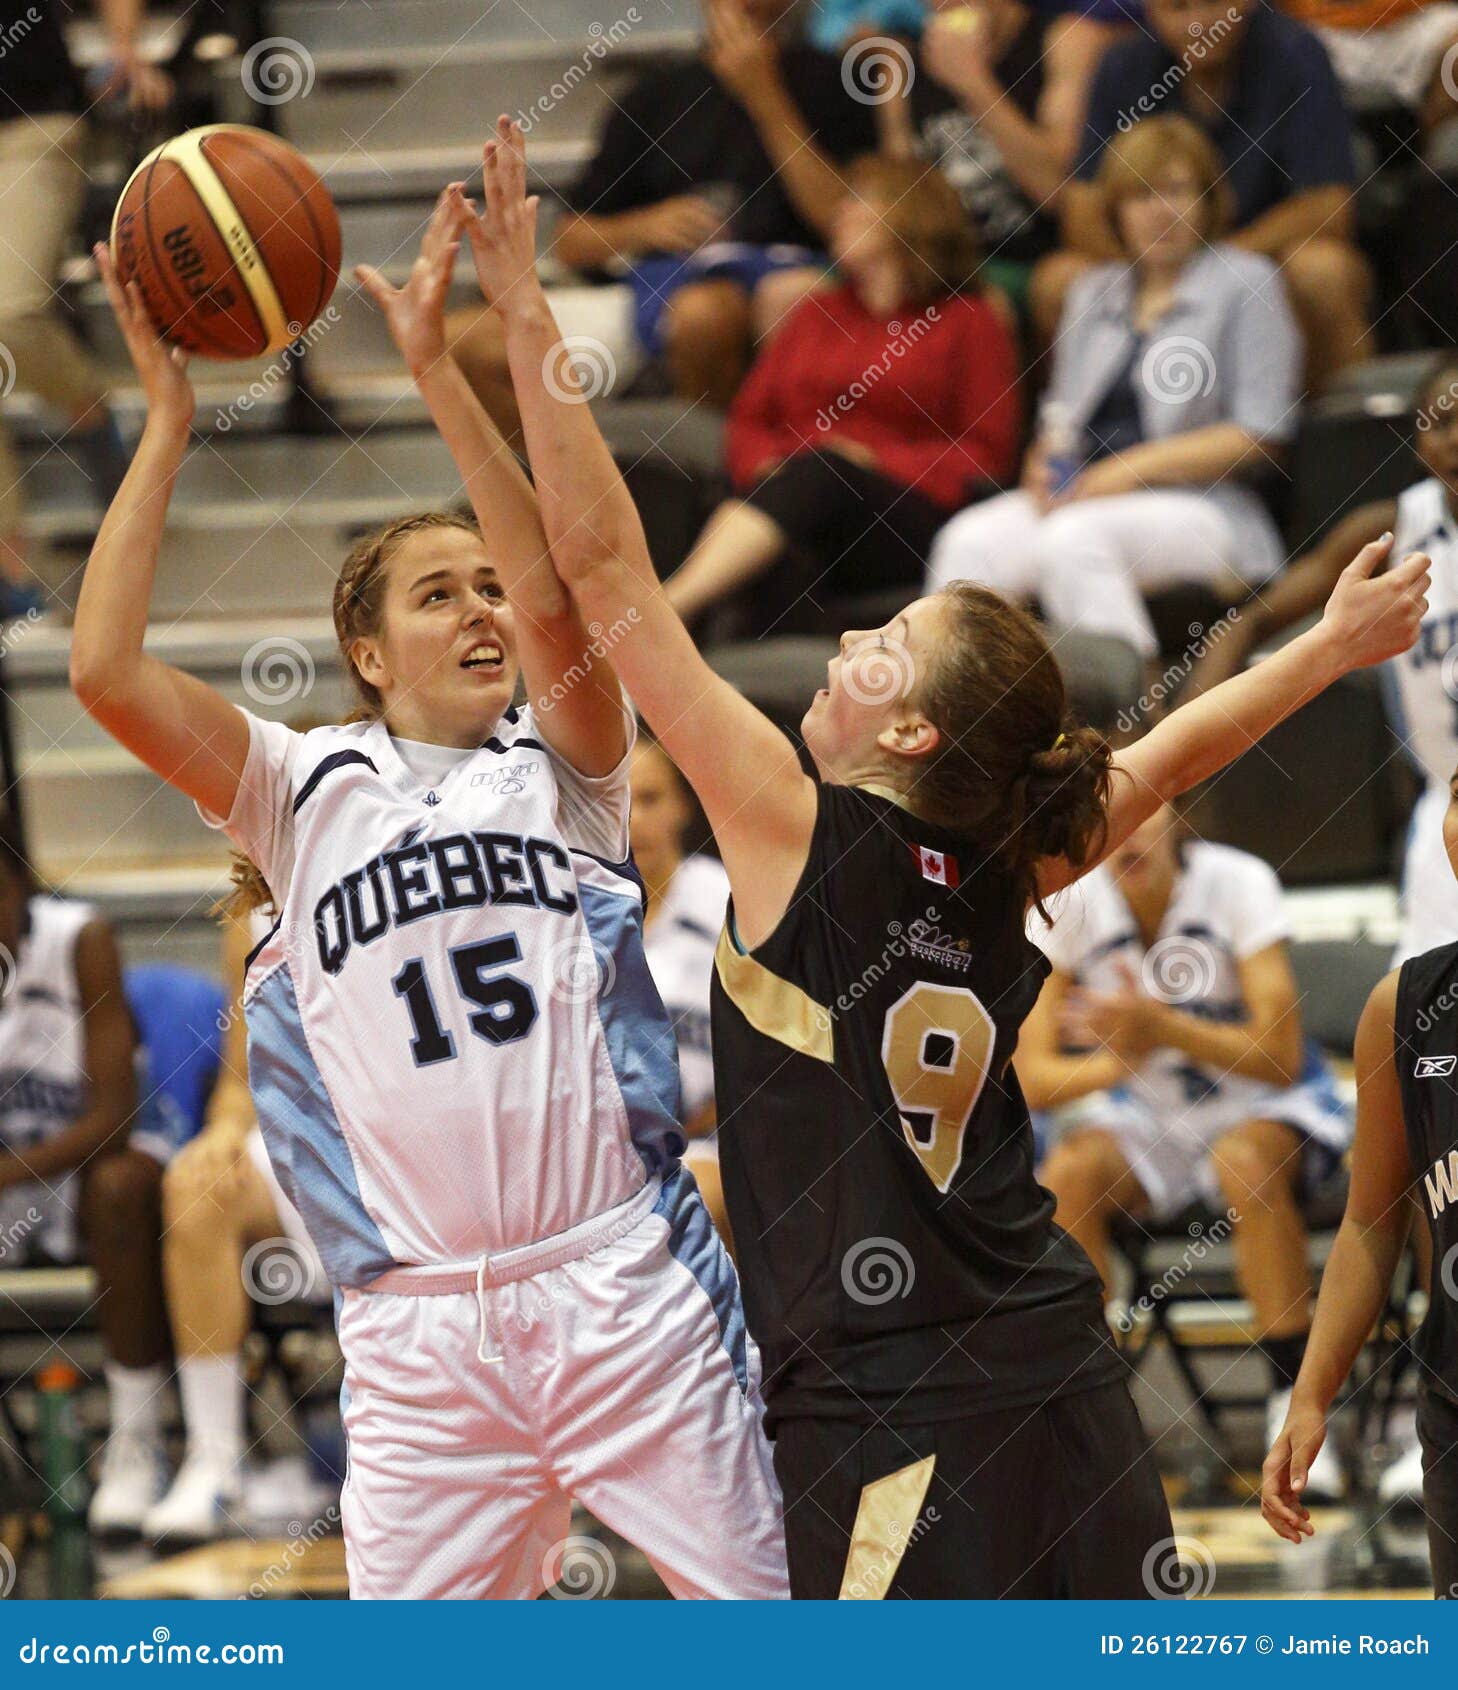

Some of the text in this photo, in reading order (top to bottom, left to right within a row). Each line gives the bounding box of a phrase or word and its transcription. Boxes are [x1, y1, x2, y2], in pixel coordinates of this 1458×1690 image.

[313, 823, 578, 977] QUÉBEC
[391, 930, 540, 1068] 15
[881, 980, 996, 1194] 9
